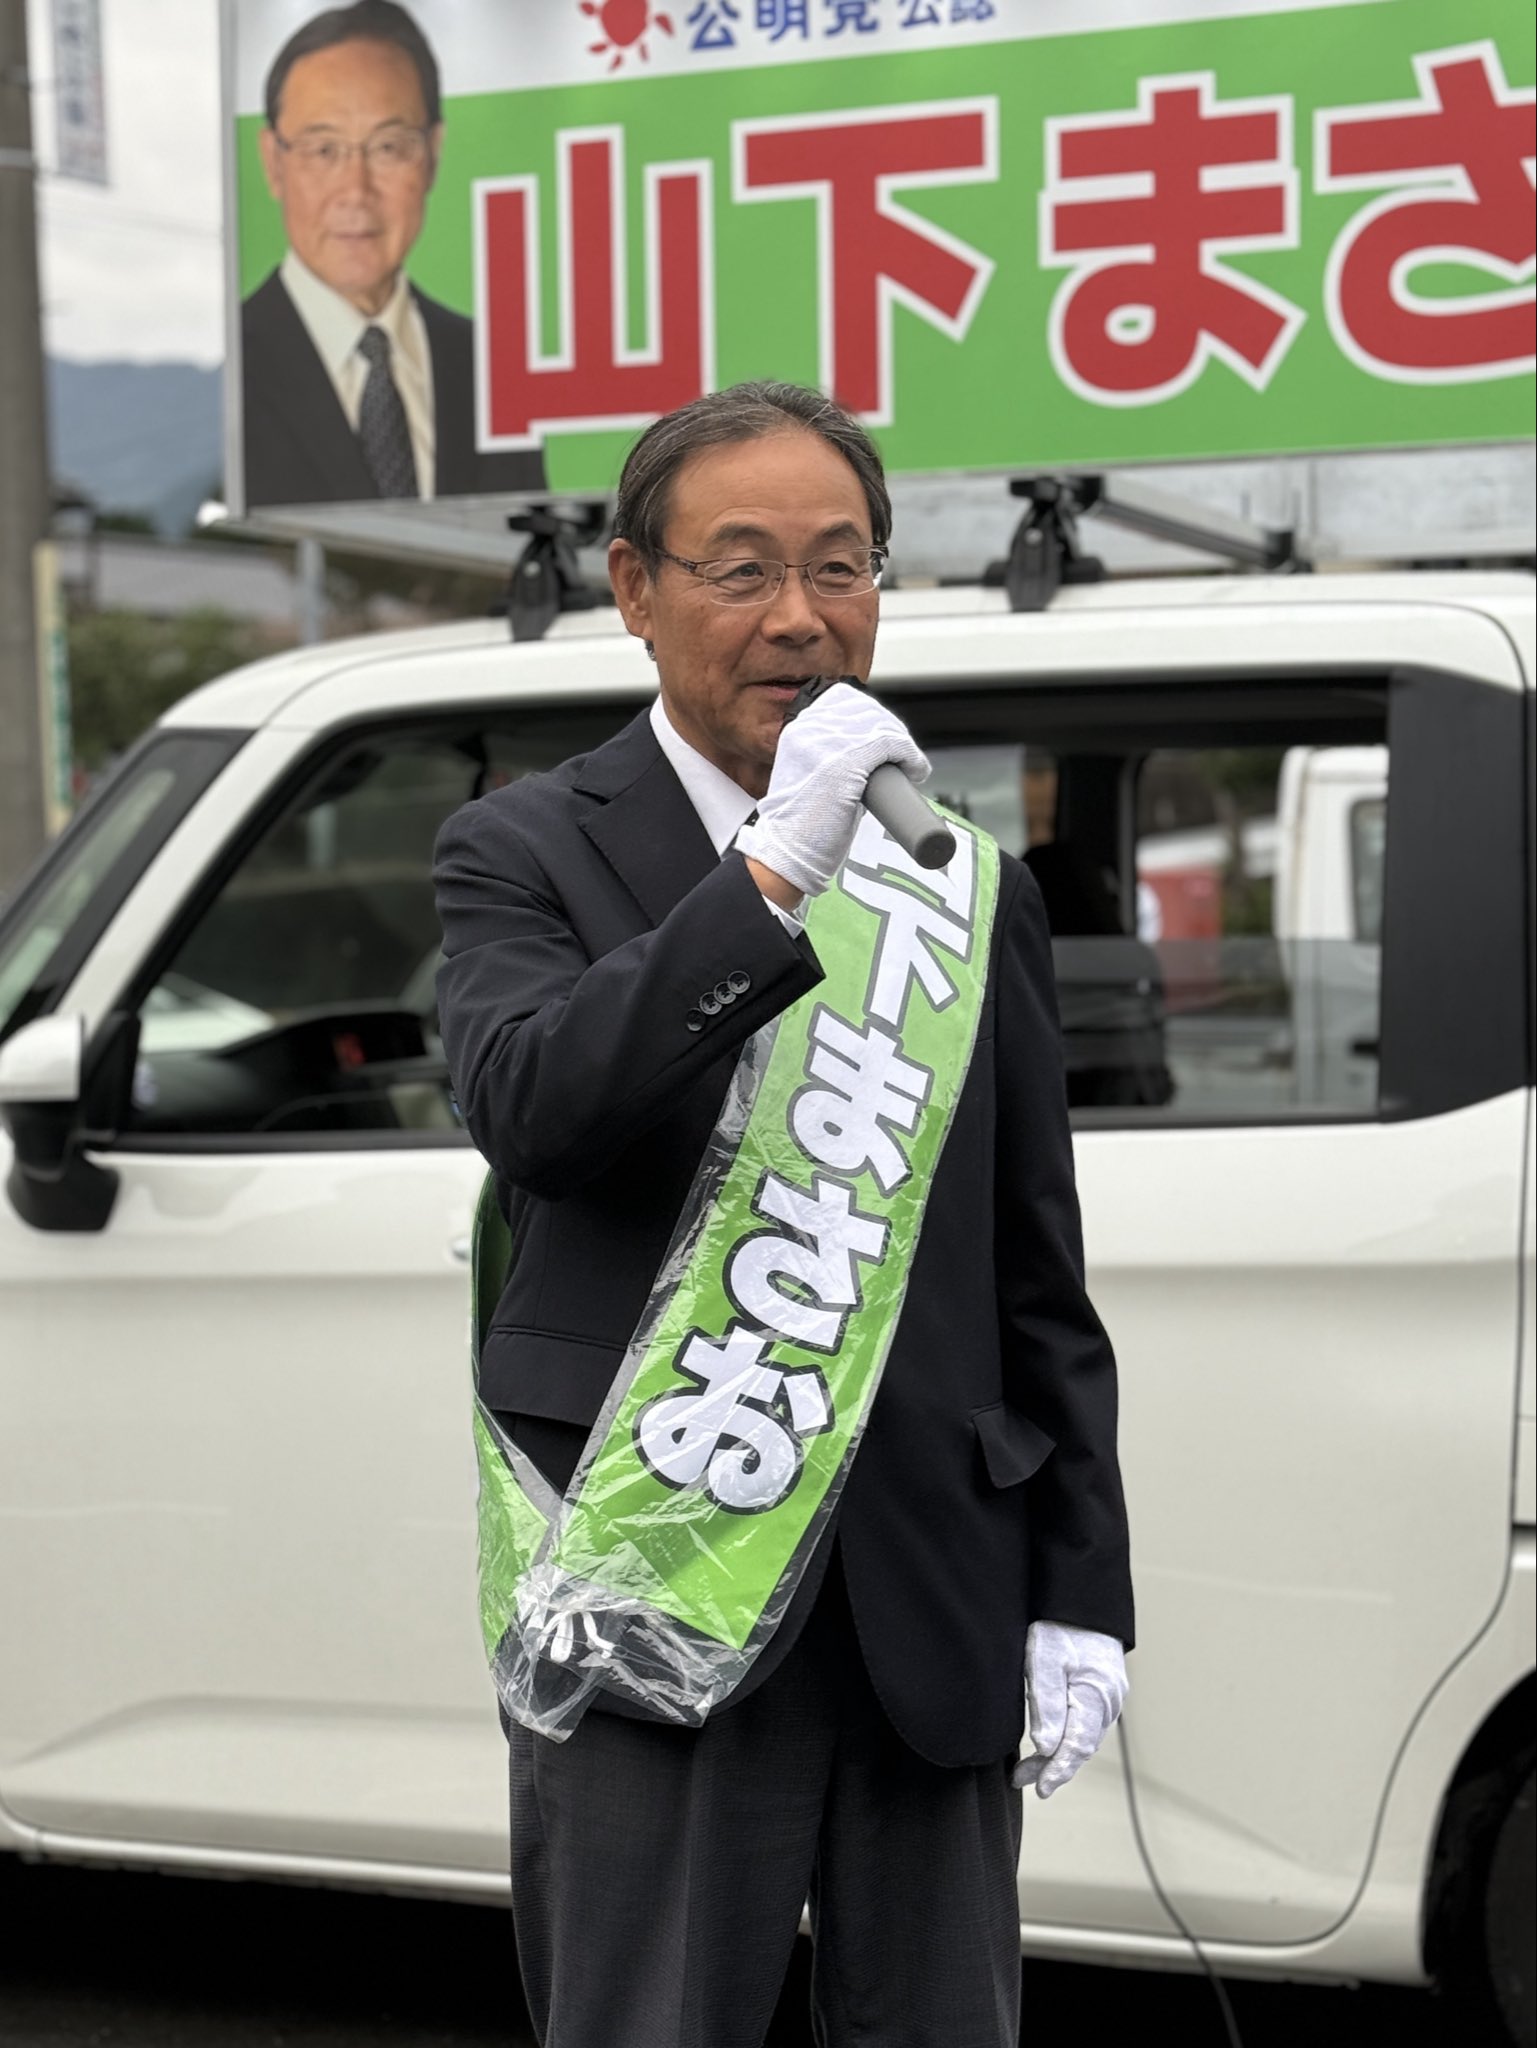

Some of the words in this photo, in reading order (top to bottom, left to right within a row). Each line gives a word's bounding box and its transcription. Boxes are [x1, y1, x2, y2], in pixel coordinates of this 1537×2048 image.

[686, 0, 880, 50] 公明党
[472, 39, 1537, 453] 山下まさ
